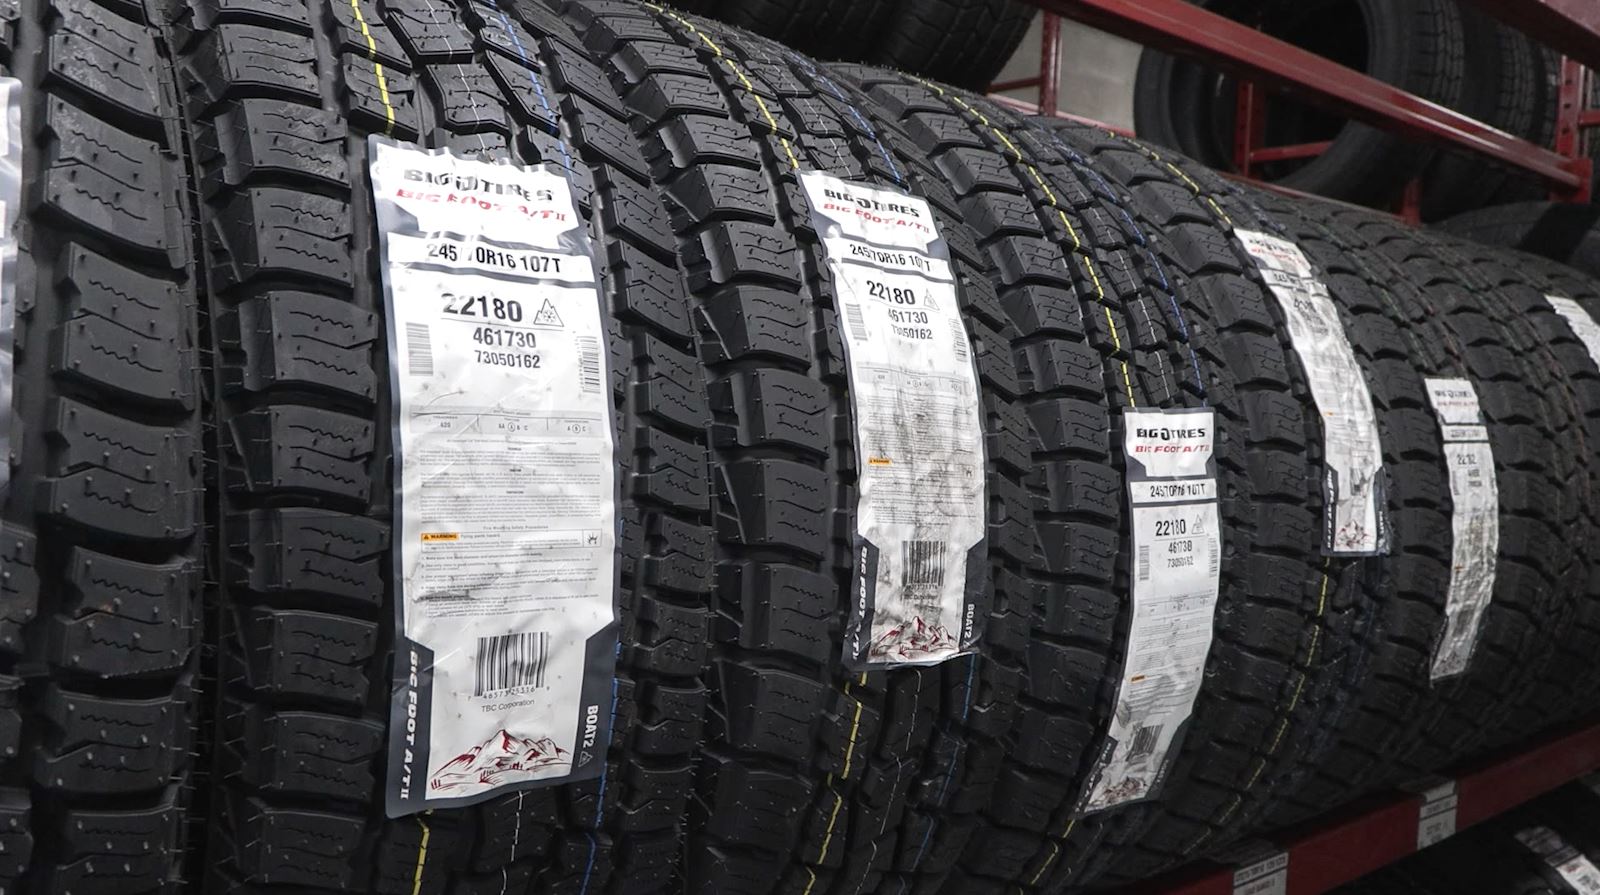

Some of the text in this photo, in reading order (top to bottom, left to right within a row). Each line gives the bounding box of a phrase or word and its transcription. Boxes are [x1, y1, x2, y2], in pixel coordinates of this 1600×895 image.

[823, 188, 853, 203] BIG
[871, 199, 920, 218] TIRES
[823, 203, 852, 213] BIG
[855, 208, 894, 225] FOOT
[519, 255, 561, 274] 107T
[908, 254, 931, 272] 107T
[866, 279, 916, 306] 22180
[440, 292, 524, 323] 22180
[887, 308, 929, 325] 461730
[472, 326, 537, 349] 461730
[474, 349, 541, 369] 73050162
[1136, 428, 1158, 438] BIG
[1169, 428, 1206, 439] TIRES
[1154, 445, 1182, 454] FOOT
[1155, 518, 1187, 537] 22180
[860, 545, 868, 575] BIG
[859, 576, 867, 619] FOOT
[964, 603, 975, 640] BOAT2
[409, 650, 419, 688] BIG
[481, 698, 535, 713] TBC Corporation
[406, 690, 419, 746] FOOT
[582, 704, 599, 749] BOAT2
